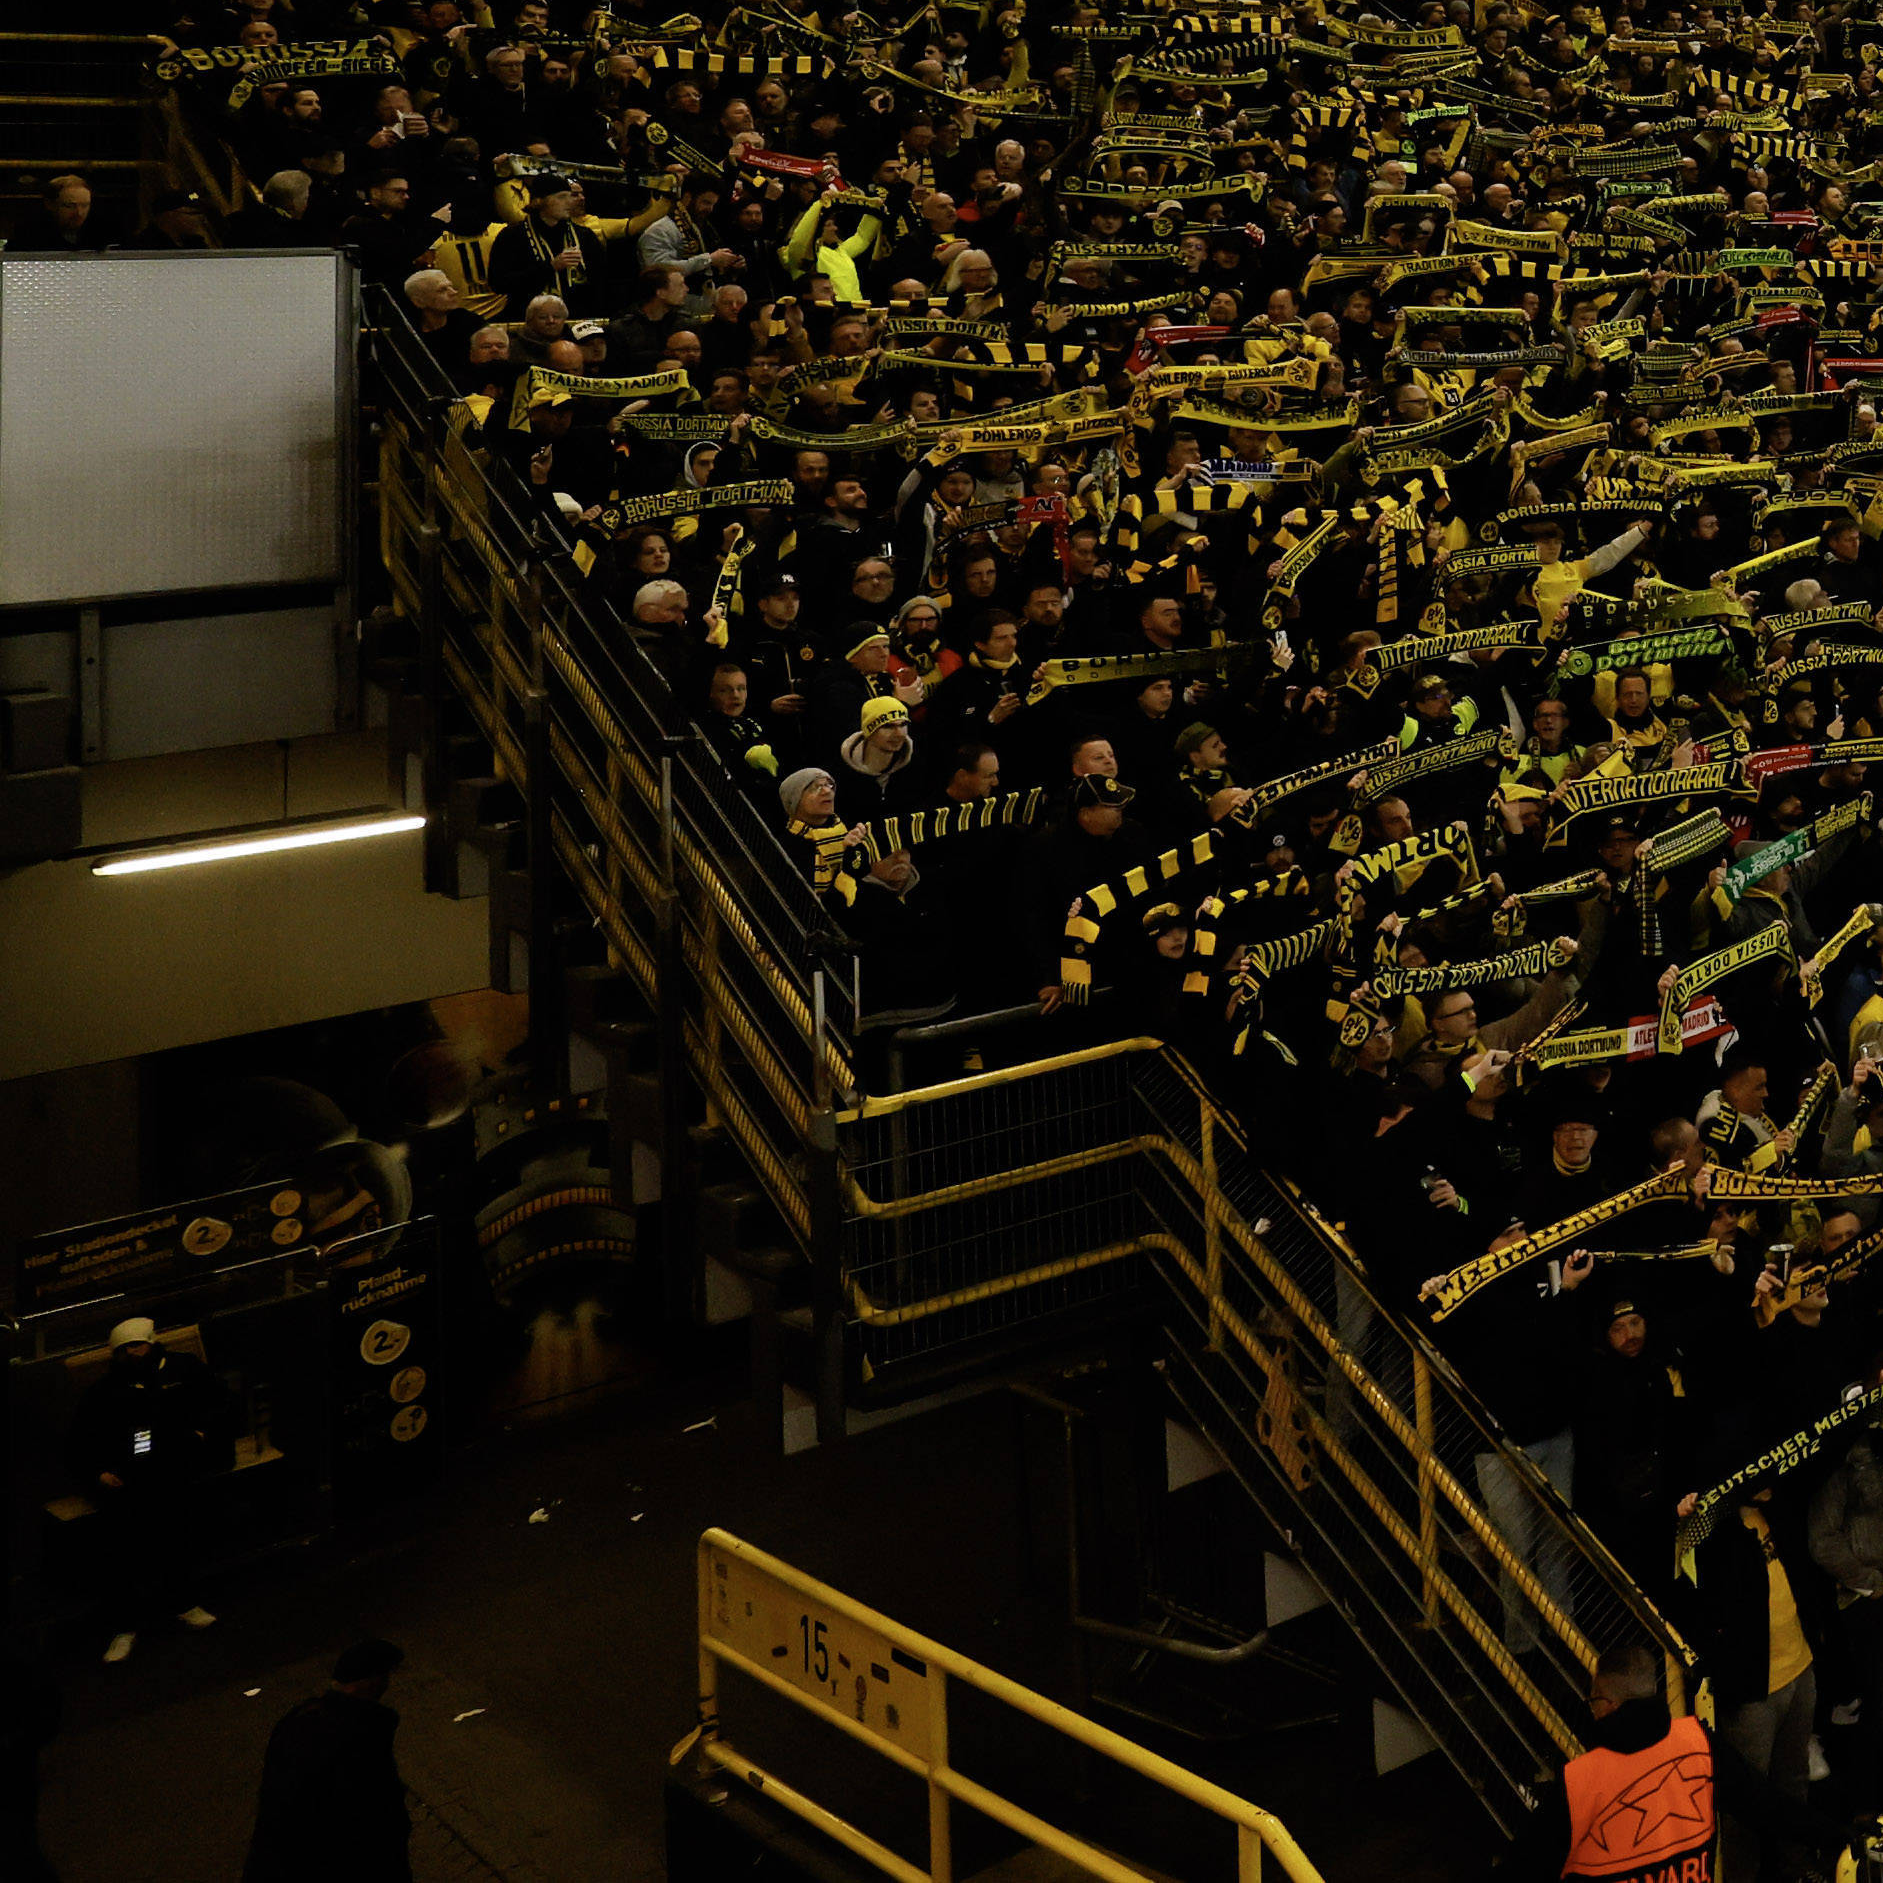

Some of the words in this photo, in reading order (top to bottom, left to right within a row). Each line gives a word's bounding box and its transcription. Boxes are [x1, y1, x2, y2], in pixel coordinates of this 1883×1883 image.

[675, 415, 733, 431] DORTMUN
[624, 489, 704, 522] BORUSSIA
[1448, 553, 1482, 572] USSIA
[1484, 548, 1539, 569] DORTM
[1769, 609, 1816, 634] RUSSIA
[1817, 602, 1873, 625] DORTMU
[1577, 1035, 1623, 1057] DORTMUND
[341, 1270, 429, 1315] rücknahme
[357, 1268, 409, 1292] Pfand-
[1696, 1430, 1811, 1516] DEUTSCHER
[1777, 1438, 1822, 1476] 2012
[799, 1613, 830, 1684] 15
